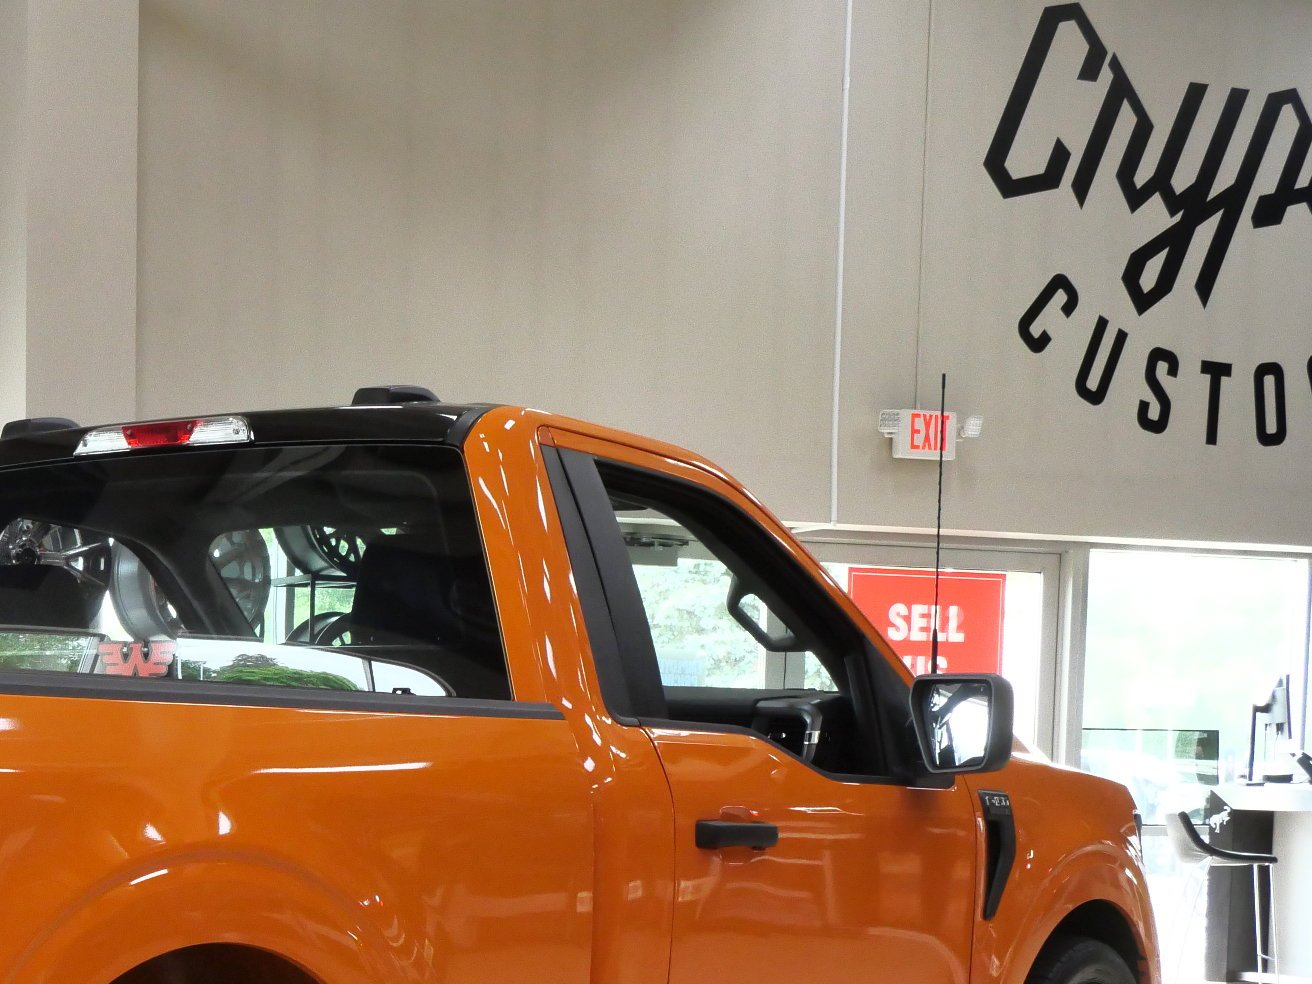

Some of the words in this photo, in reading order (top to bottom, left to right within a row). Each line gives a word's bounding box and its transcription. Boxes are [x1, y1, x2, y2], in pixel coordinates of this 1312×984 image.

[983, 2, 1312, 316] Cryp
[1018, 273, 1312, 446] CUSTO
[910, 413, 951, 451] EXIT
[888, 603, 965, 643] SELL
